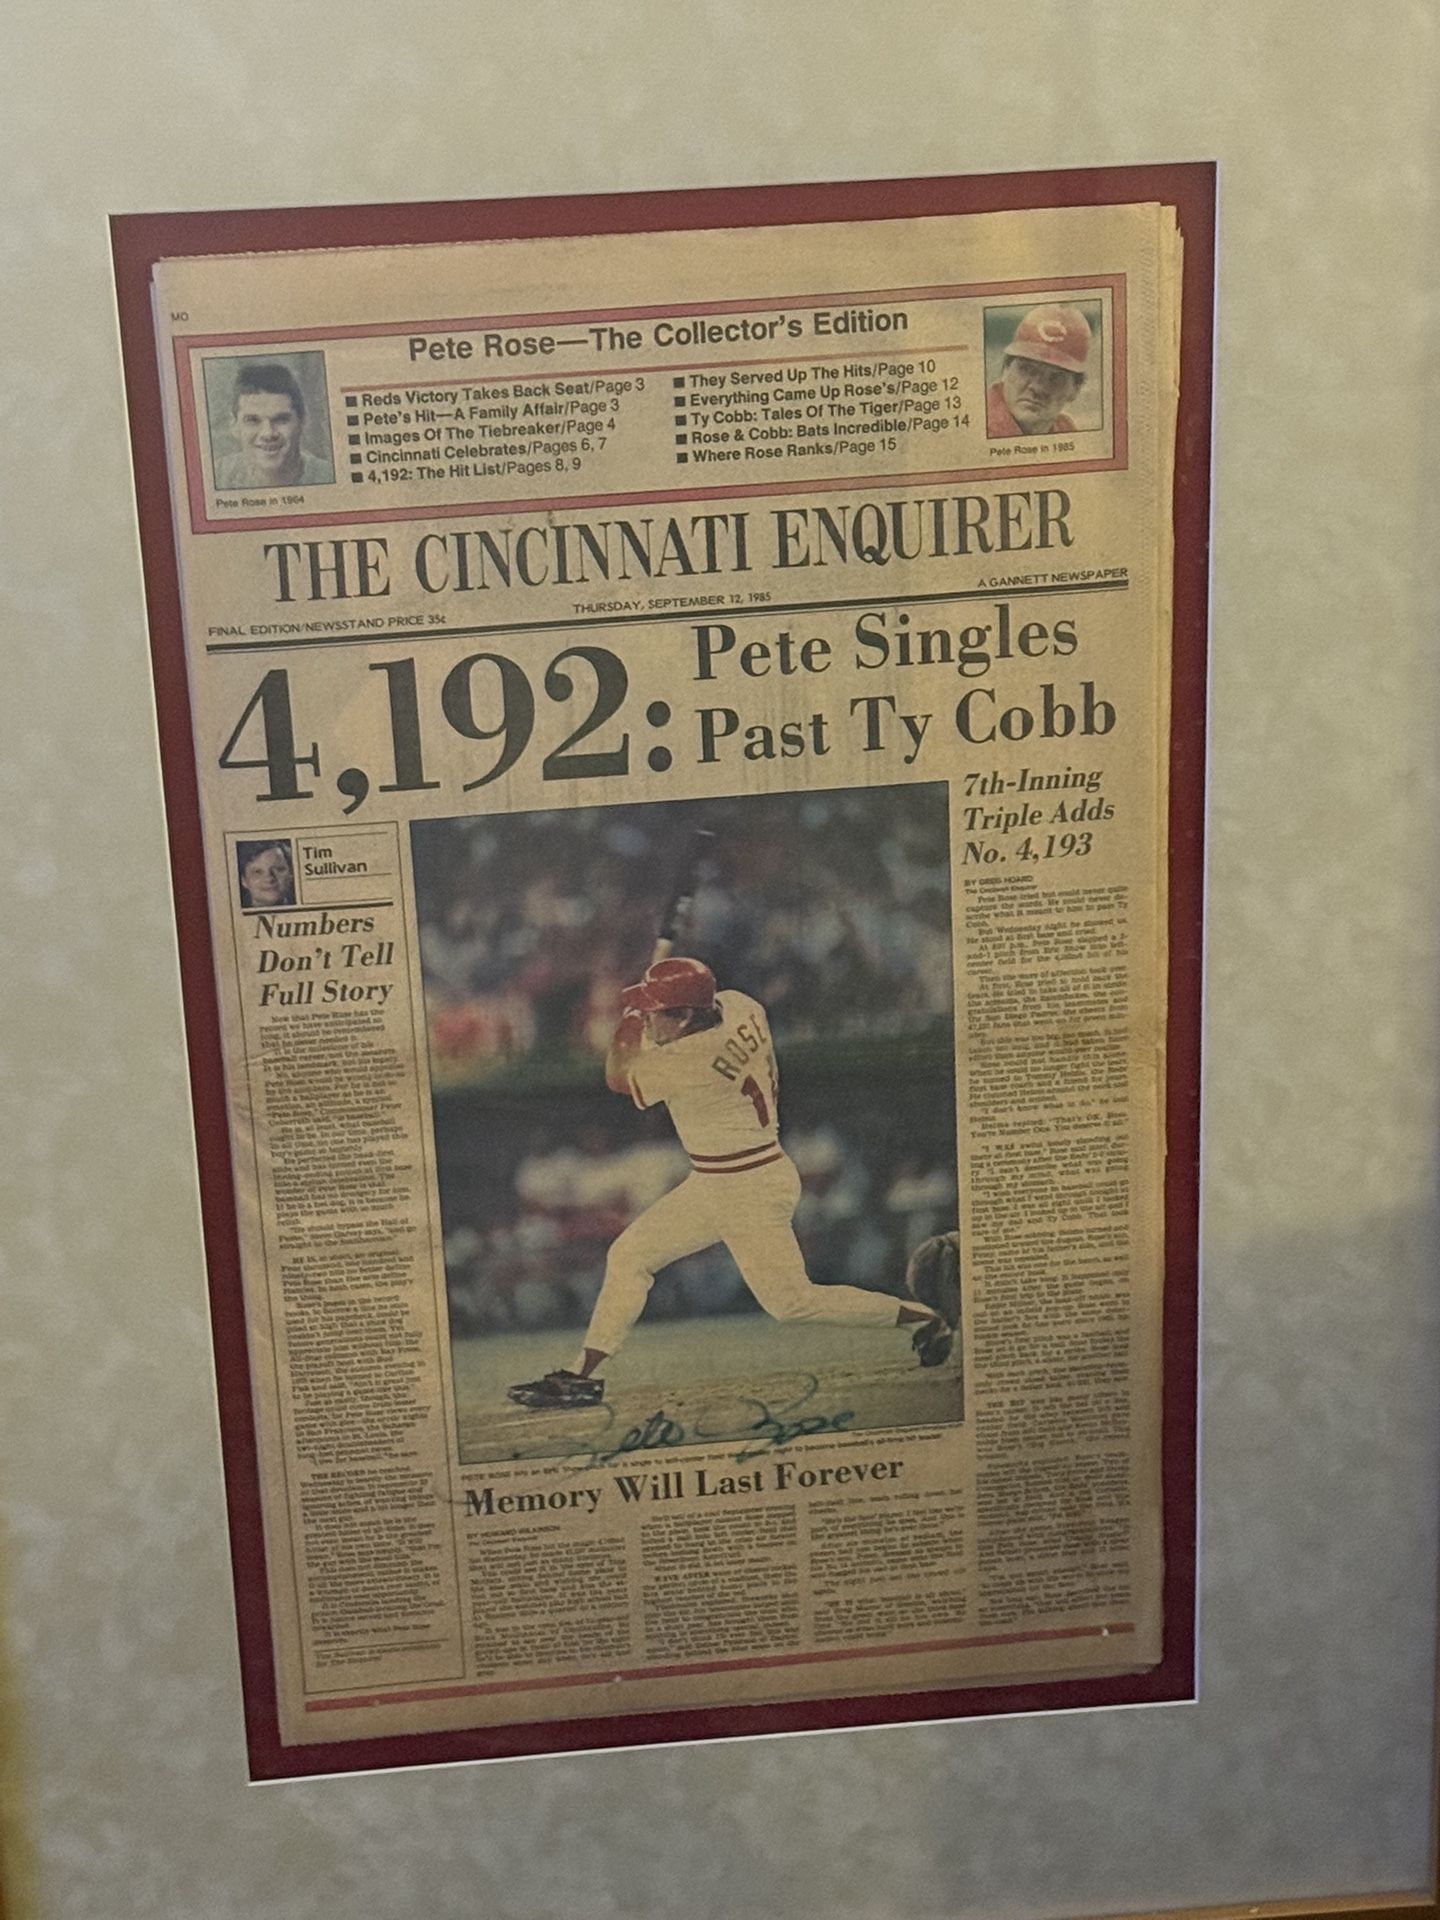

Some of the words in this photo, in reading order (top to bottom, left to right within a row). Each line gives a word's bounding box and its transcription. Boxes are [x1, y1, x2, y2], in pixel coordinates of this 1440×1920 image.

[409, 337, 473, 361] Pete
[654, 315, 803, 347] Collector's
[814, 309, 908, 336] Edition
[689, 374, 726, 389] They
[731, 370, 783, 386] Served
[787, 368, 807, 384] Up
[811, 365, 839, 380] The
[843, 362, 914, 379] Hits/Page
[918, 359, 936, 374] 10
[362, 393, 400, 407] Reds
[406, 389, 458, 405] Victory
[463, 386, 509, 401] Takes
[513, 383, 550, 397] Back
[554, 379, 633, 396] Seat/Page
[635, 377, 645, 391] 3
[690, 388, 769, 408] Everything
[774, 386, 816, 402] Came
[820, 385, 840, 402] Up
[942, 377, 959, 391] 12
[364, 411, 411, 426] Pete's
[470, 404, 517, 420] Family
[523, 399, 607, 417] Affair/Page
[610, 399, 620, 412] 3
[691, 412, 709, 427] Ty
[713, 408, 758, 424] Cobb:
[761, 406, 802, 421] Tales
[806, 403, 824, 418] Of
[828, 402, 856, 417] The
[860, 397, 941, 416] Tiger/Page
[946, 395, 962, 410] 13
[365, 429, 420, 446] Images
[424, 427, 442, 441] Of
[446, 426, 475, 440] The
[479, 420, 603, 439] Tiebreaker/Page
[607, 418, 616, 431] 4
[692, 429, 730, 445] Rose
[734, 428, 745, 442] &
[749, 425, 793, 441] Cobb:
[796, 422, 829, 437] Bats
[833, 416, 949, 436] Incredible/Page
[953, 414, 970, 428] 14
[366, 447, 440, 464] Cincinnati
[444, 440, 577, 460] Celebrates/Pages
[598, 437, 607, 450] 7
[693, 448, 741, 463] Where
[745, 445, 783, 460] Rose
[787, 439, 876, 458] Ranks/Page
[880, 437, 897, 452] 15
[368, 468, 413, 485] 4,192:
[417, 466, 445, 480] The
[450, 464, 471, 478] Hit
[474, 459, 552, 477] List/Pages
[572, 457, 581, 471] 9
[263, 537, 390, 601] THE
[415, 511, 753, 594] CINCINNATI
[770, 488, 1075, 570] ENQUIRER
[977, 579, 986, 588] A
[989, 573, 1049, 588] GANNETT
[1051, 567, 1128, 583] NEWSPAPER
[573, 601, 645, 614] THURSDAY,
[648, 595, 725, 610] SEPTEMBER
[748, 591, 772, 603] 1985
[208, 625, 246, 637] FINAL
[388, 614, 425, 627] PRICE
[691, 624, 832, 680] Pete
[855, 603, 1079, 678] Singles
[217, 646, 673, 815] 4,192:
[695, 707, 832, 764] Past
[850, 695, 934, 765] Ty
[955, 681, 1117, 744] Cobb
[964, 766, 1103, 797] 7th-Inning
[963, 803, 1043, 834] Triple
[1048, 797, 1116, 824] Adds
[303, 846, 333, 860] Tim
[961, 840, 1007, 865] No.
[1016, 831, 1094, 865] 4,193
[304, 860, 368, 877] Sullivan
[254, 912, 375, 939] Numbers
[256, 947, 332, 974] Don't
[341, 942, 395, 968] Tell
[258, 980, 314, 1007] Full
[321, 979, 394, 1005] Story
[465, 1486, 603, 1518] Memory
[614, 1470, 684, 1503] Will
[696, 1468, 765, 1497] Last
[774, 1459, 904, 1490] Forever
